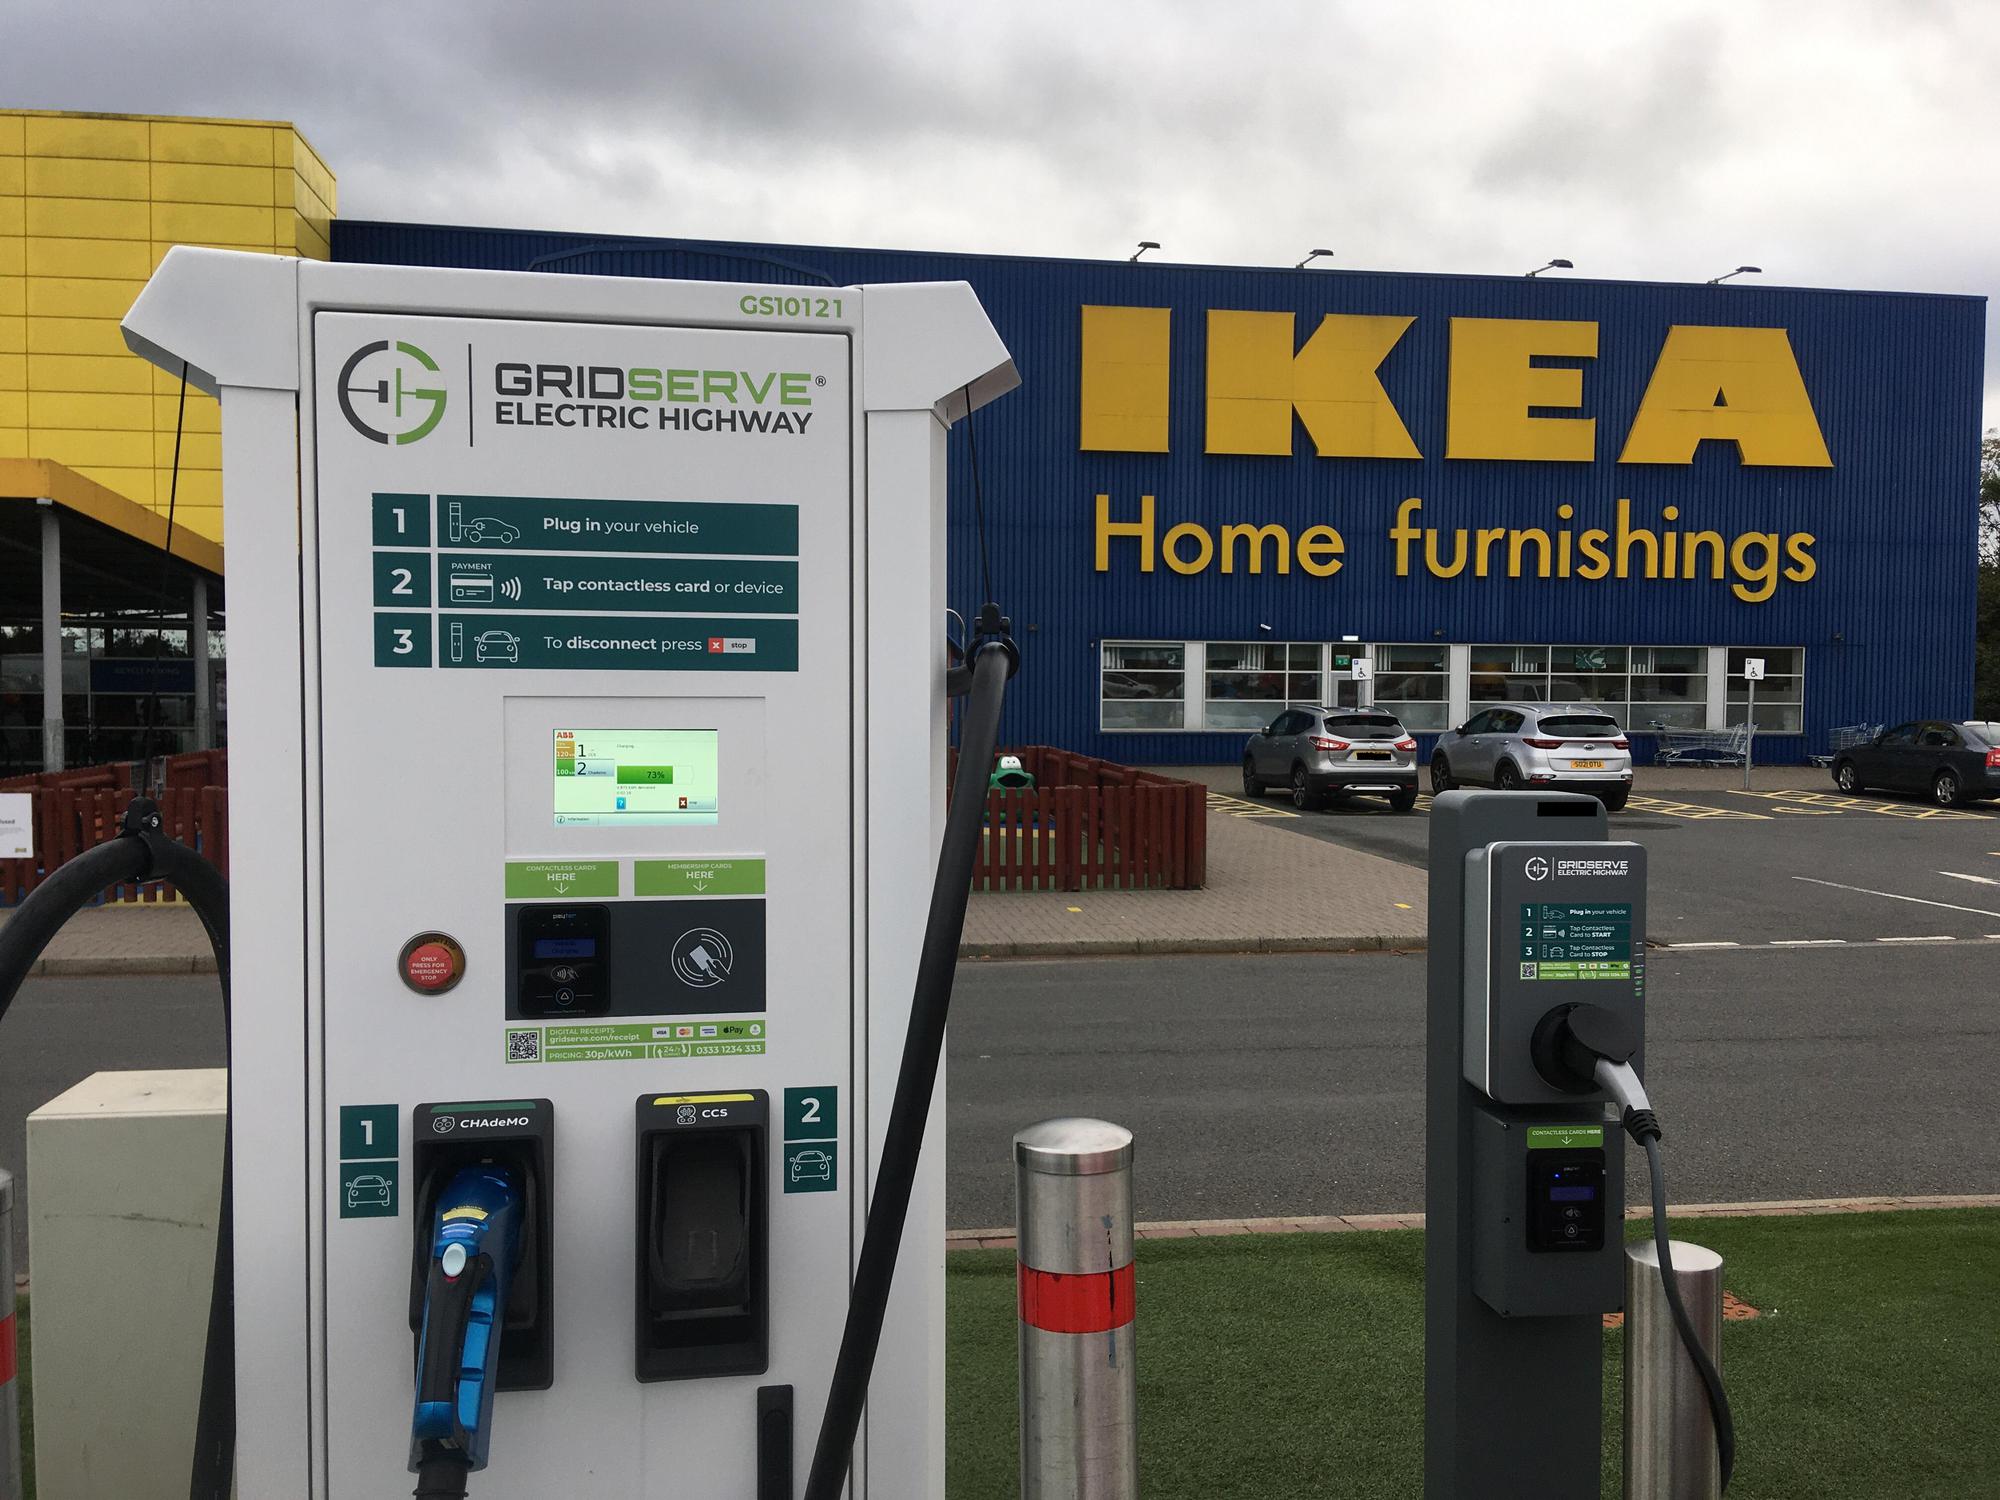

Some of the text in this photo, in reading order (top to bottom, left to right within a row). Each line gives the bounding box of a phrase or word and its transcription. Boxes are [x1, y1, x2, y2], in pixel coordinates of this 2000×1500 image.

[739, 295, 842, 318] GS10121
[1080, 305, 1834, 468] IKEA
[495, 401, 812, 435] ELECTRIC HIGHWAY
[392, 508, 405, 533] 1
[543, 517, 699, 534] Plug in your vehicle
[1095, 494, 1818, 603] Home furnishings
[391, 568, 413, 595] 2
[543, 577, 784, 595] Tap contactless card or device
[392, 629, 413, 654] 3
[543, 636, 747, 653] To disconnect press stop
[578, 744, 586, 758] 1
[577, 762, 587, 775] 2
[647, 771, 665, 779] 73%
[1558, 861, 1628, 869] GRIDSERVE
[547, 873, 577, 881] HERE
[686, 871, 714, 879] HERE
[1526, 908, 1531, 917] 1
[1525, 928, 1533, 937] 2
[1526, 947, 1533, 956] 3
[580, 1027, 615, 1035] RECEIPTS
[585, 1049, 632, 1060] 30p/kWh
[696, 1045, 761, 1055] 0333 1234 333
[701, 1109, 728, 1118] CCS
[801, 1097, 821, 1123] 2
[460, 1117, 529, 1129] CHAdeMO
[361, 1120, 374, 1145] 1
